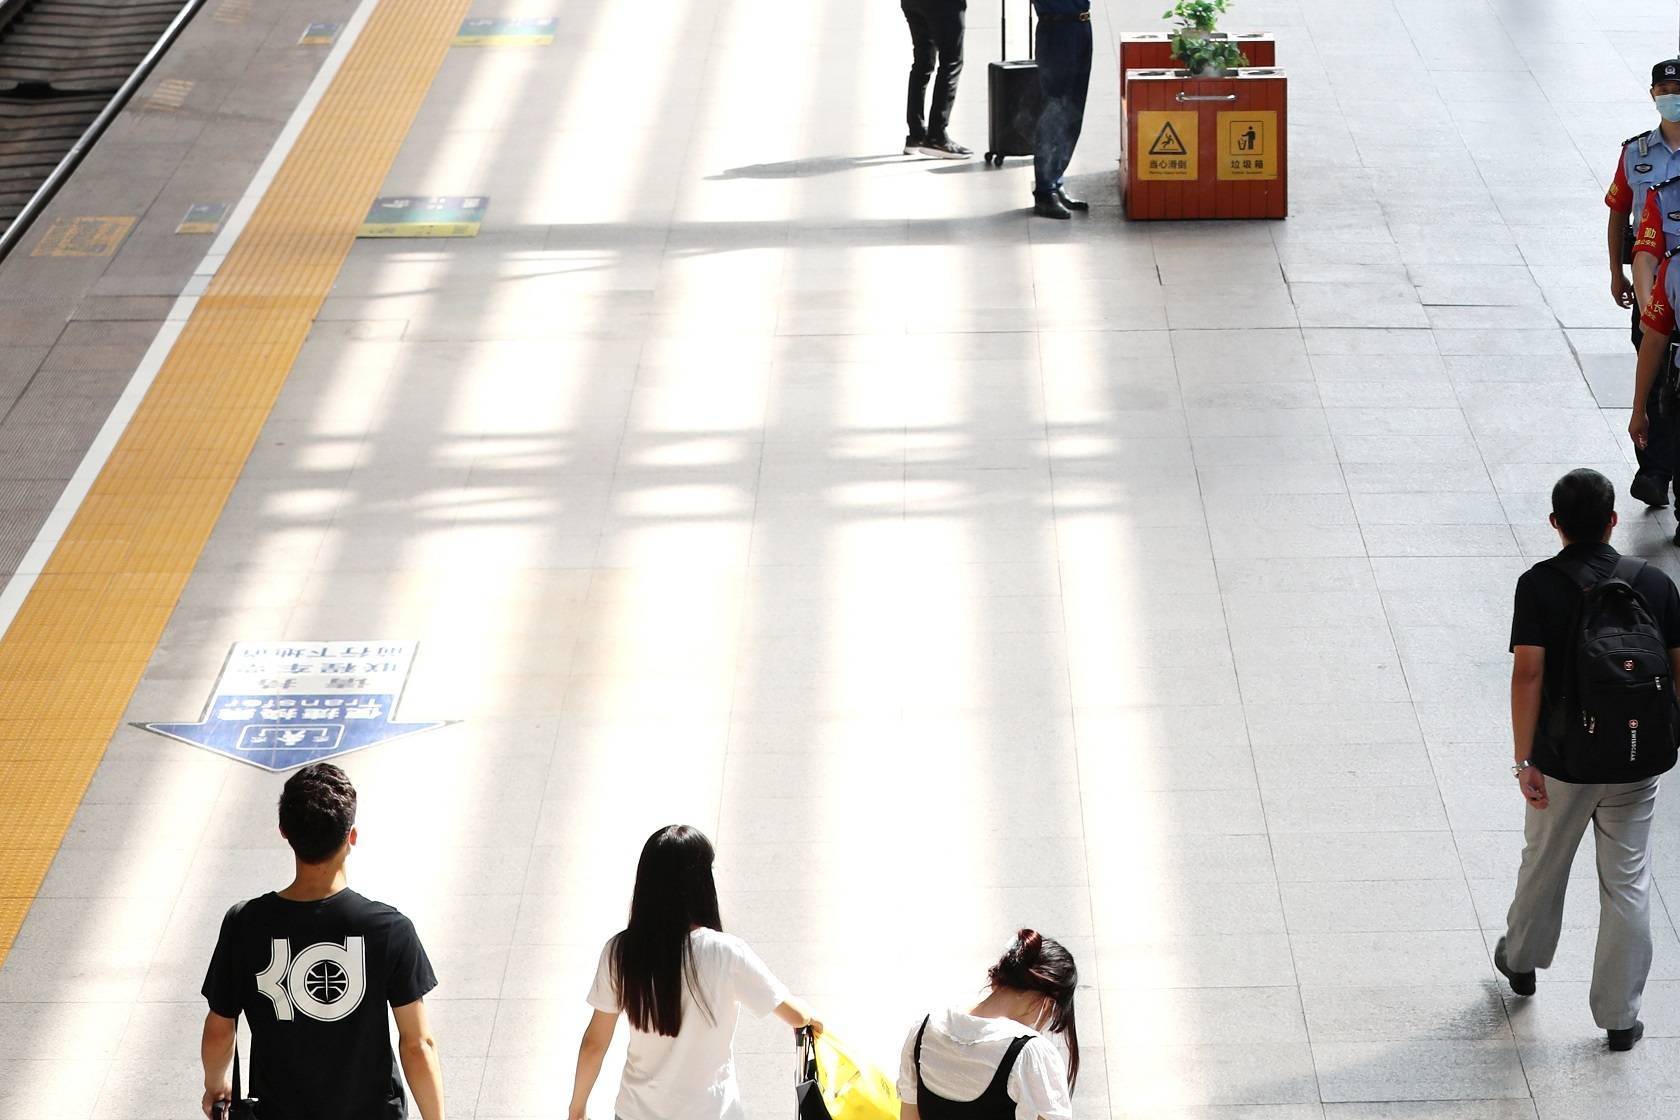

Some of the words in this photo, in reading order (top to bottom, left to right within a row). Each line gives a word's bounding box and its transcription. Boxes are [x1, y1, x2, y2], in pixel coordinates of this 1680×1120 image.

[1231, 160, 1264, 169] 垃圾箱
[224, 698, 383, 708] Transfer
